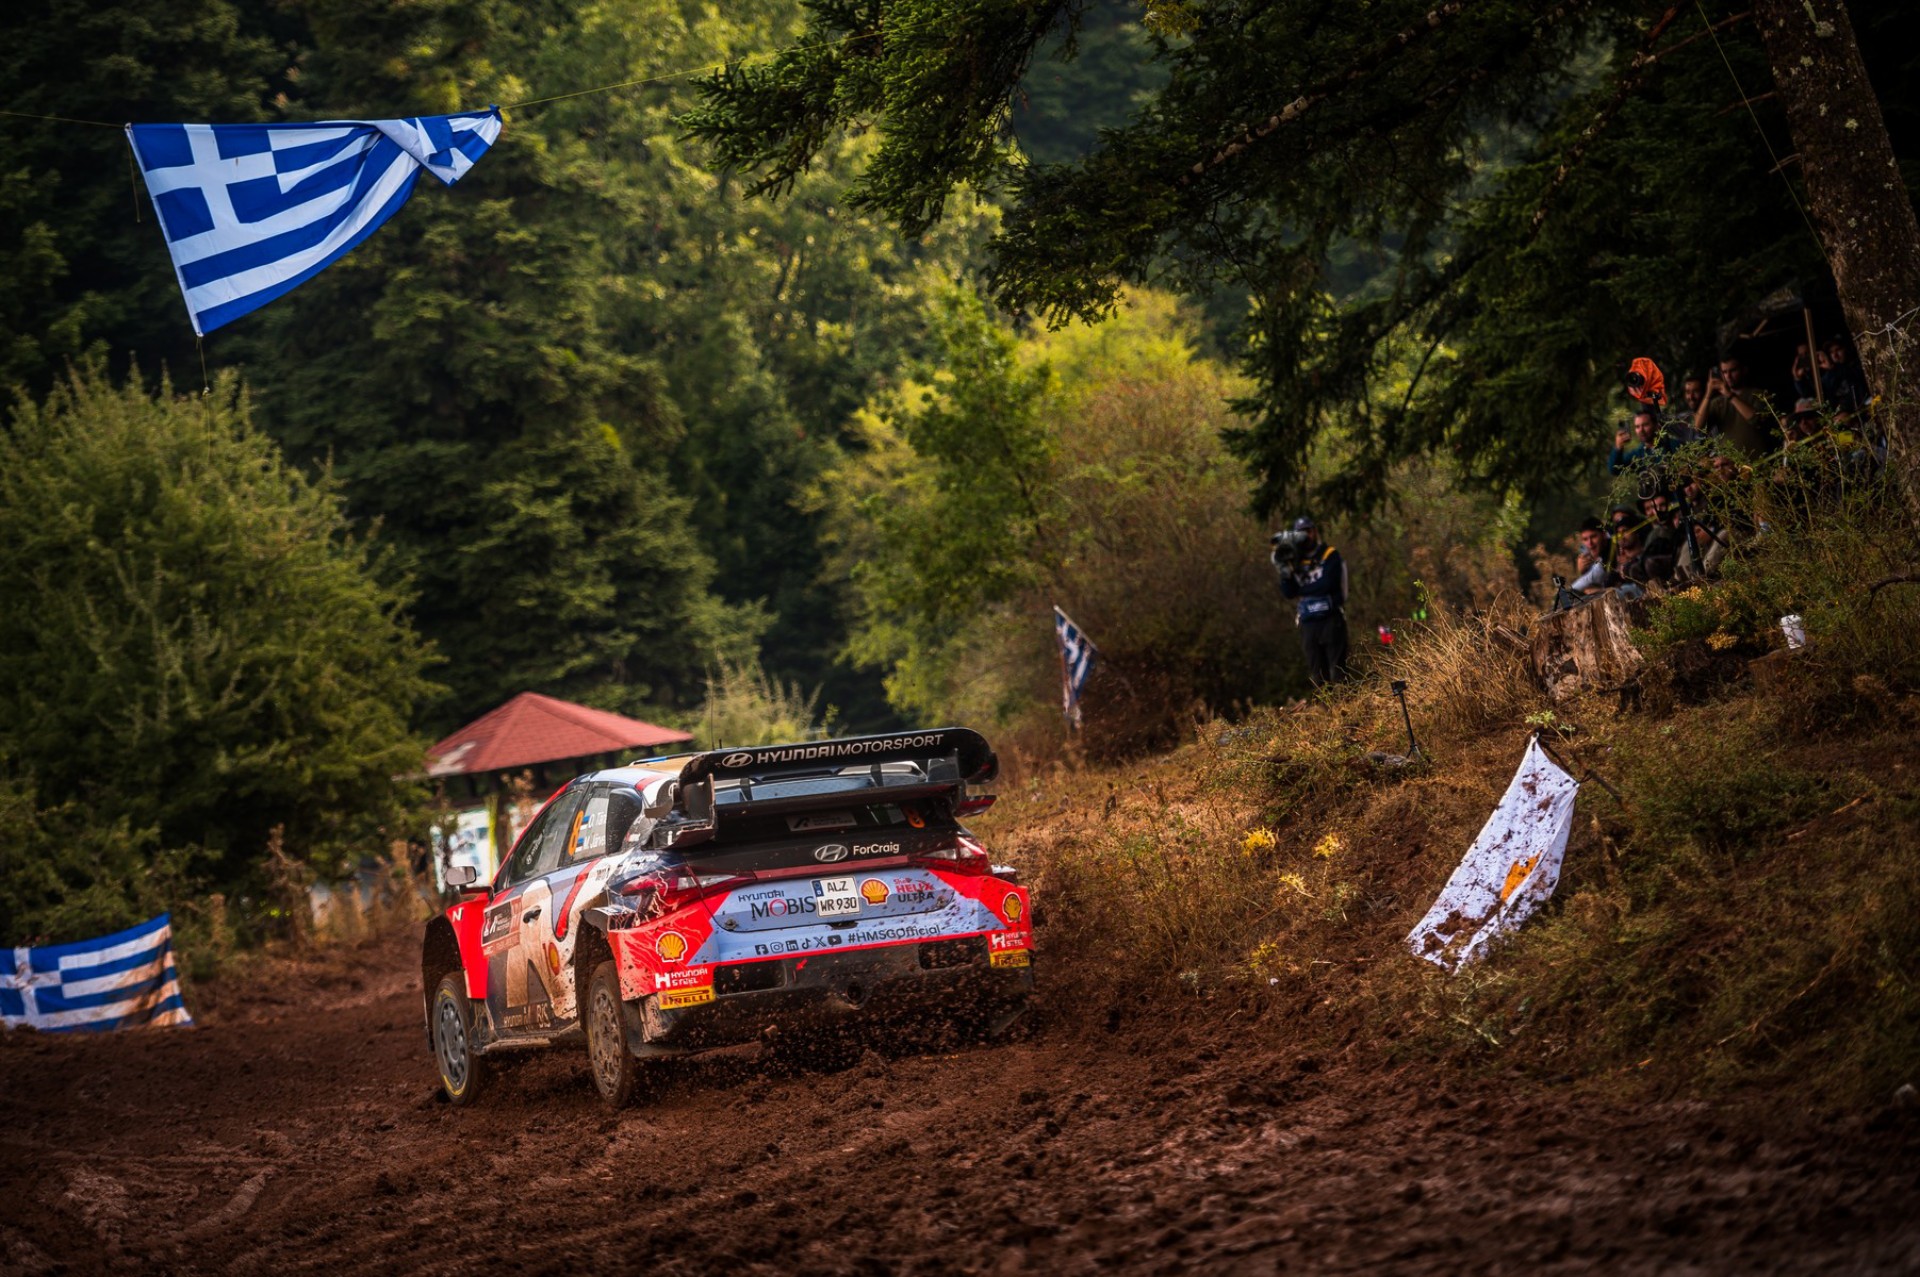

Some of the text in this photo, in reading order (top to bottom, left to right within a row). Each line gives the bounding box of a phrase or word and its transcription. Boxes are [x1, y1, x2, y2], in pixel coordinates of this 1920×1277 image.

[757, 734, 944, 764] HYUNDAI MOTORSPORT
[827, 880, 848, 893] ALZ
[738, 890, 784, 902] HYUNDAI
[898, 891, 934, 903] ULTRA
[751, 896, 816, 919] MOBIS
[820, 897, 857, 912] WR 930
[848, 925, 940, 943] #HMSGOfficial
[671, 968, 708, 978] HYUNDAI
[672, 978, 699, 986] STEEL
